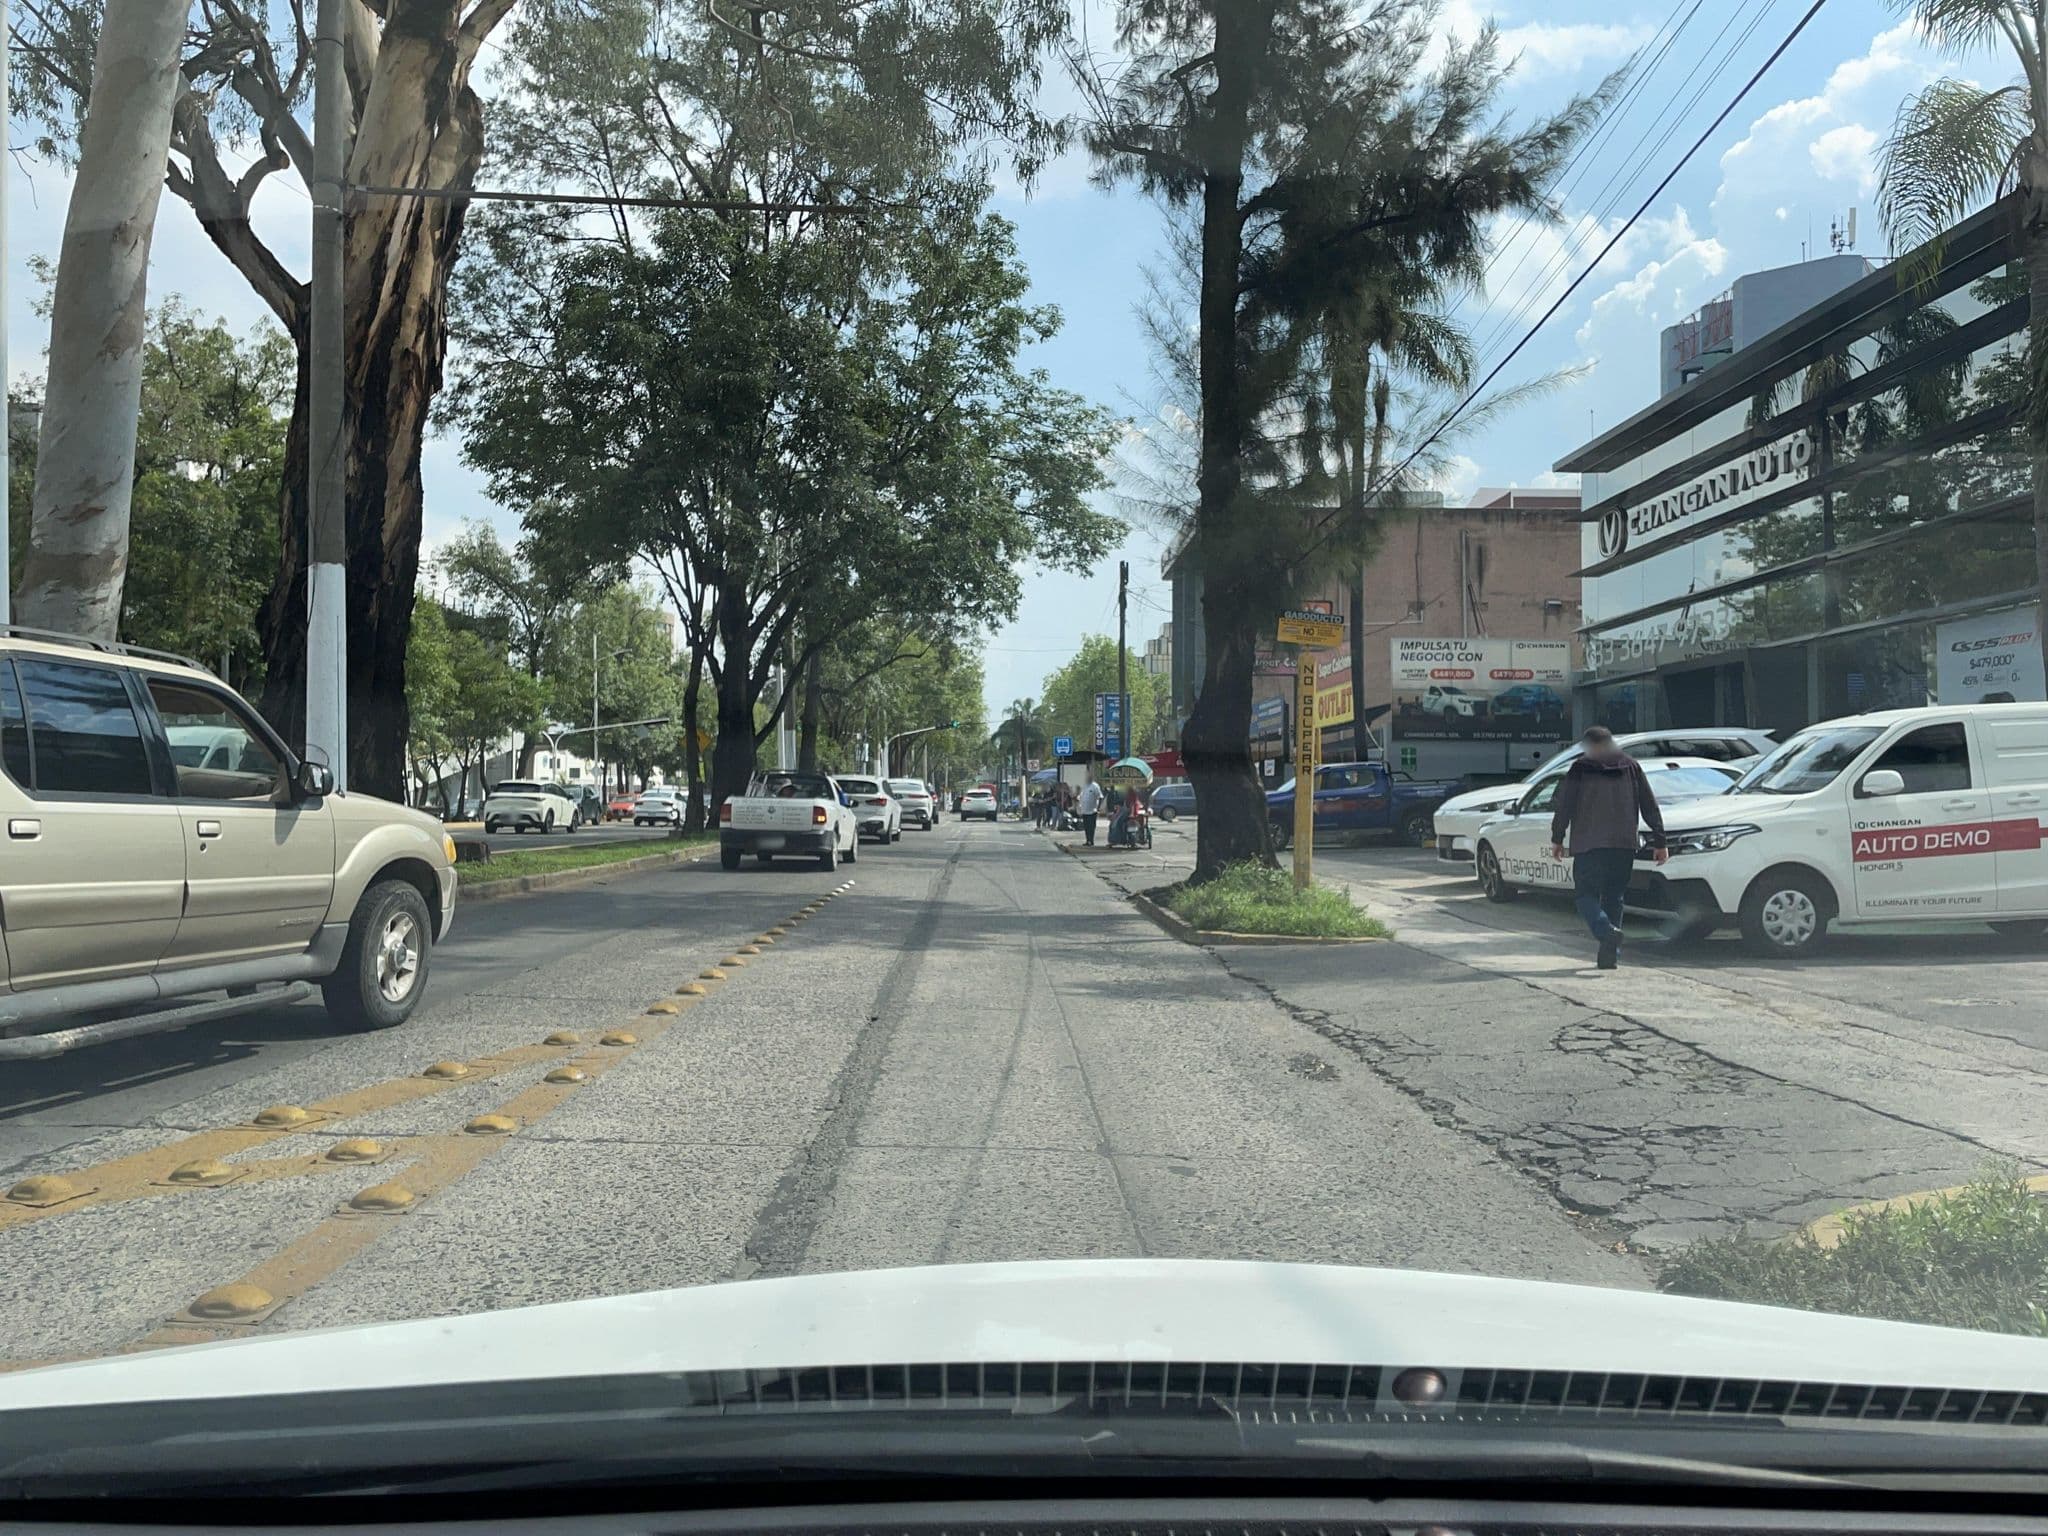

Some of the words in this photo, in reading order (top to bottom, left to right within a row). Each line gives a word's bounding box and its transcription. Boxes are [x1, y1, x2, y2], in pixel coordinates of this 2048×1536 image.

[1627, 470, 1734, 536] CHANGAN
[1737, 435, 1812, 494] AUTO
[1284, 610, 1342, 624] GASODUCTO
[1400, 641, 1450, 651] IMPULSA
[1453, 641, 1467, 650] TU
[1400, 652, 1454, 662] NEGOCIO
[1457, 652, 1483, 662] CON
[1303, 665, 1314, 685] NO
[1318, 686, 1352, 720] OUTLET
[1302, 695, 1313, 776] GOLPEAR
[1870, 819, 1921, 828] CHANGAN
[1856, 836, 1917, 855] AUTO
[1924, 830, 1990, 850] DEMO
[1859, 863, 1895, 872] HONOR
[1866, 899, 1919, 907] ILLUMINATE
